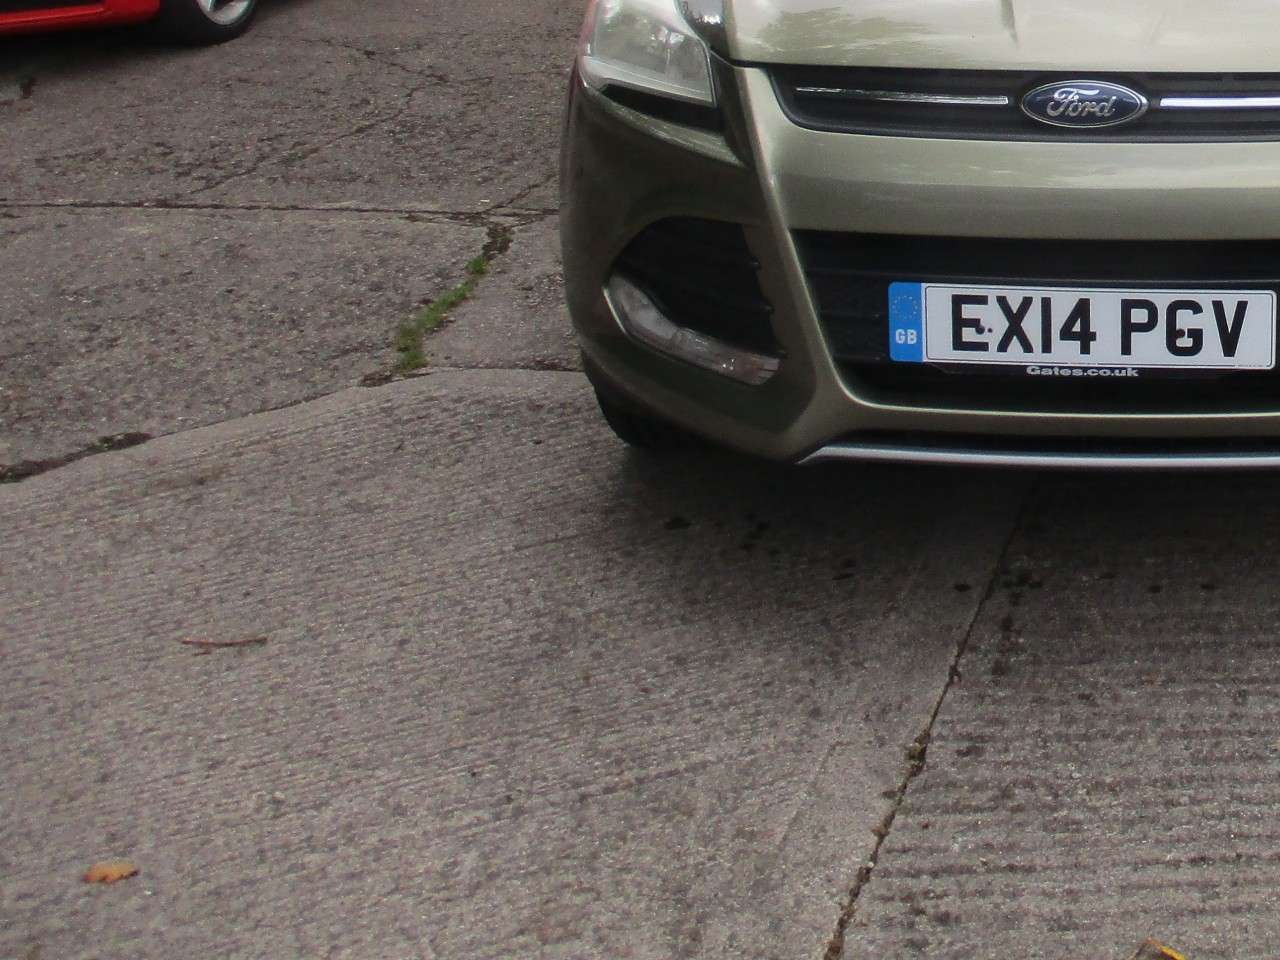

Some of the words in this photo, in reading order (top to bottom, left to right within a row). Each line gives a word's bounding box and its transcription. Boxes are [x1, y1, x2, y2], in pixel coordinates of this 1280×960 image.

[1046, 87, 1118, 117] Ford
[895, 328, 918, 345] GB
[951, 294, 1097, 355] EX14
[1120, 298, 1249, 358] PGV
[1026, 365, 1139, 378] Gates.co.uk
